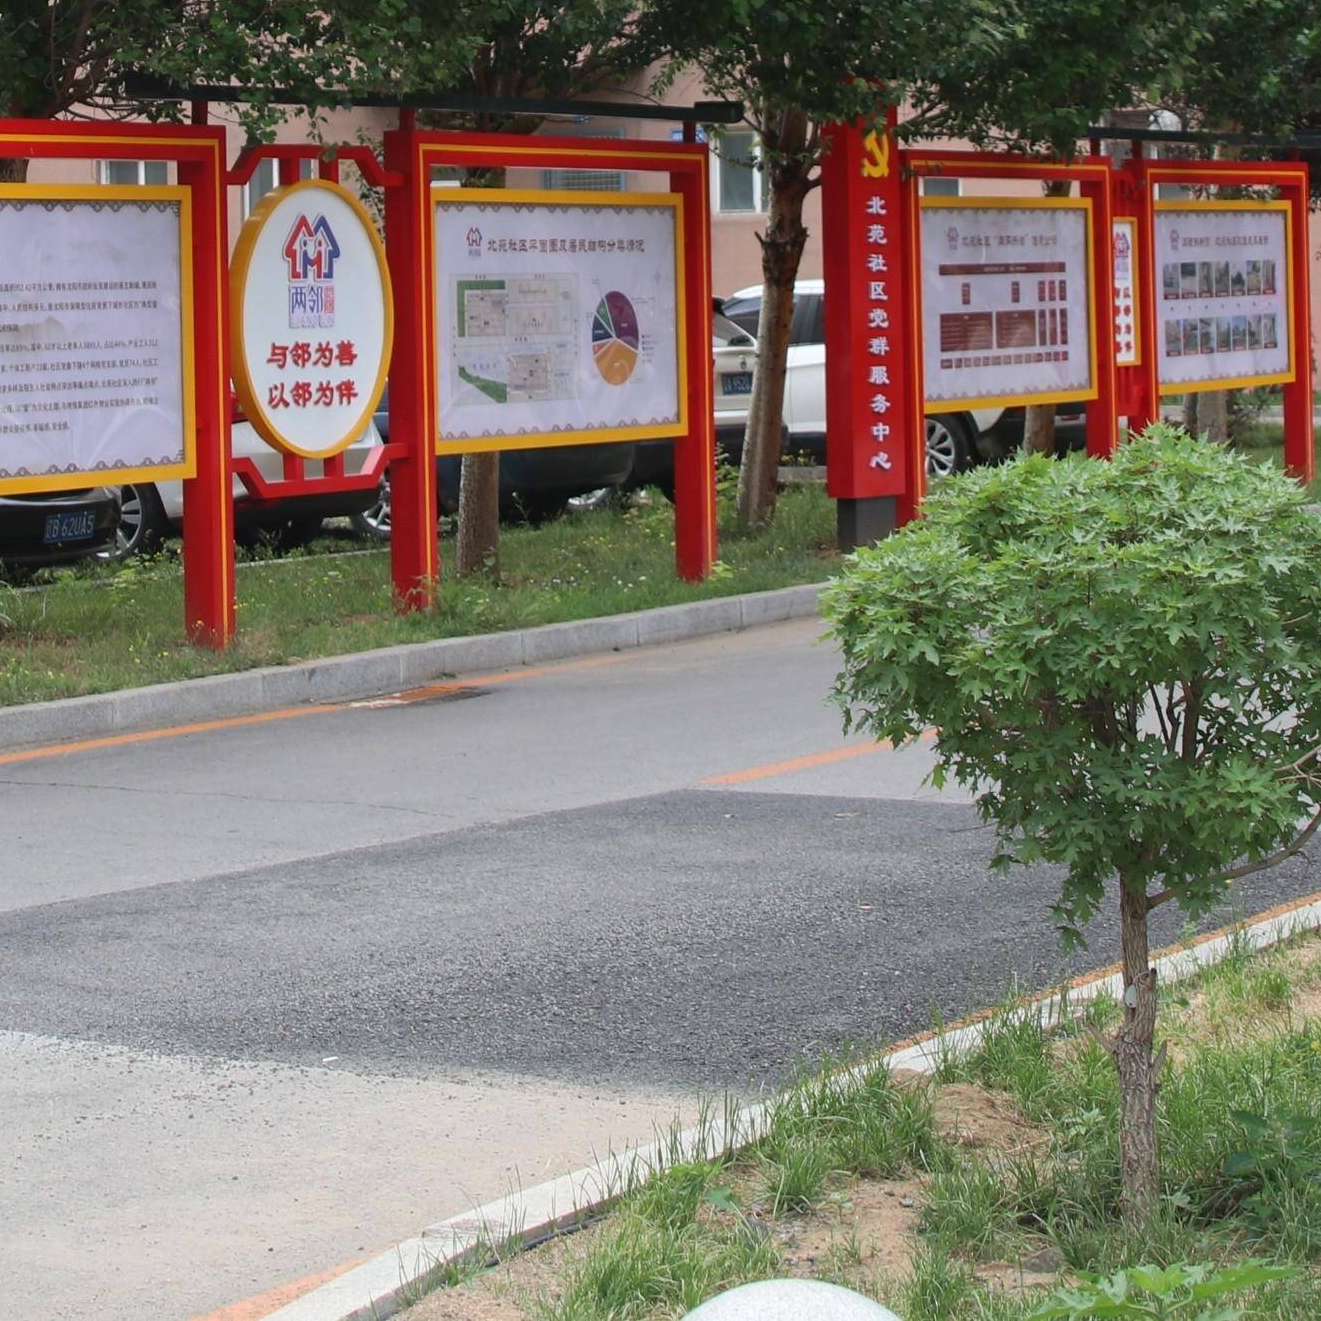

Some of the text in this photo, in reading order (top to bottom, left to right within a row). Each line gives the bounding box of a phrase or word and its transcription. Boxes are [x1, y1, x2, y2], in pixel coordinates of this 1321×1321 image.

[866, 196, 892, 471] 北苑社区党群服务中心
[266, 340, 358, 370] 与邻为善
[268, 379, 359, 410] 以邻为伴
